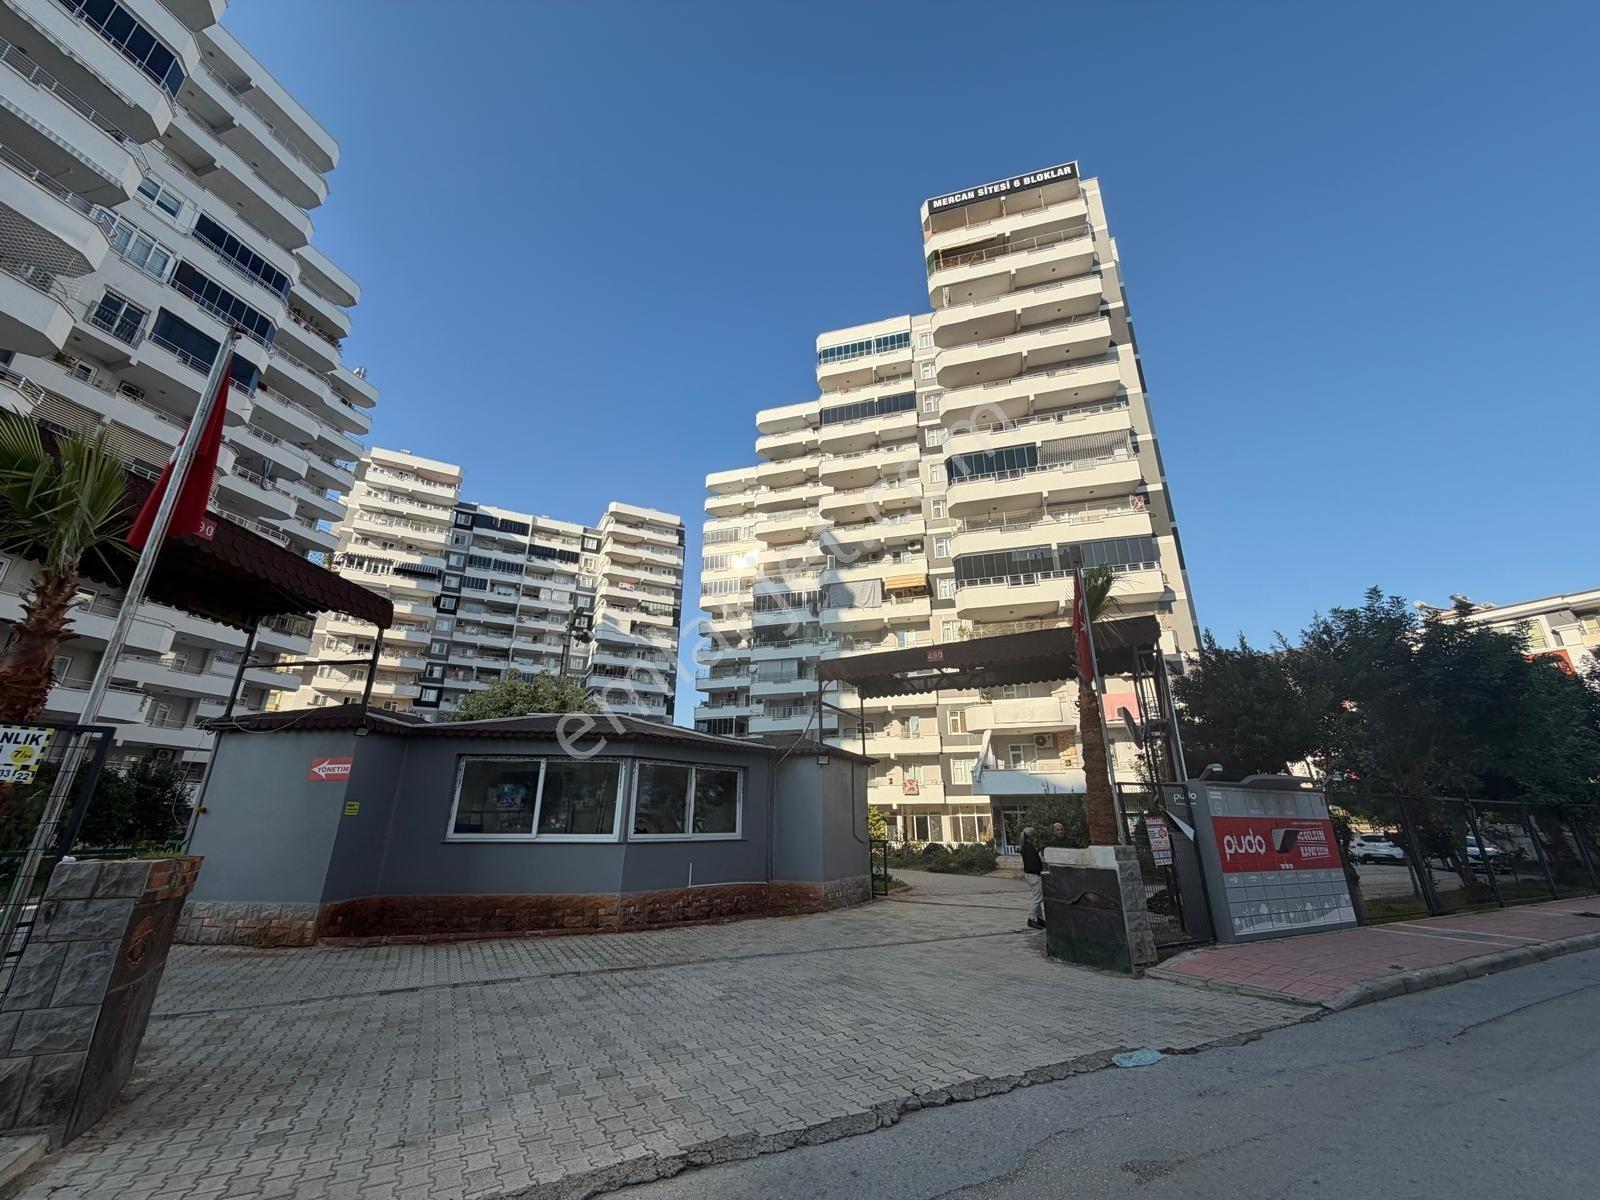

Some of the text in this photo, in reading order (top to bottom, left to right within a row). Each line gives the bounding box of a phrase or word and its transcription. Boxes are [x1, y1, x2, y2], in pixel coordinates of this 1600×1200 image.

[933, 166, 1072, 208] MERCAN SİTESİ 6 BLOKLAR
[1223, 827, 1266, 862] pudo
